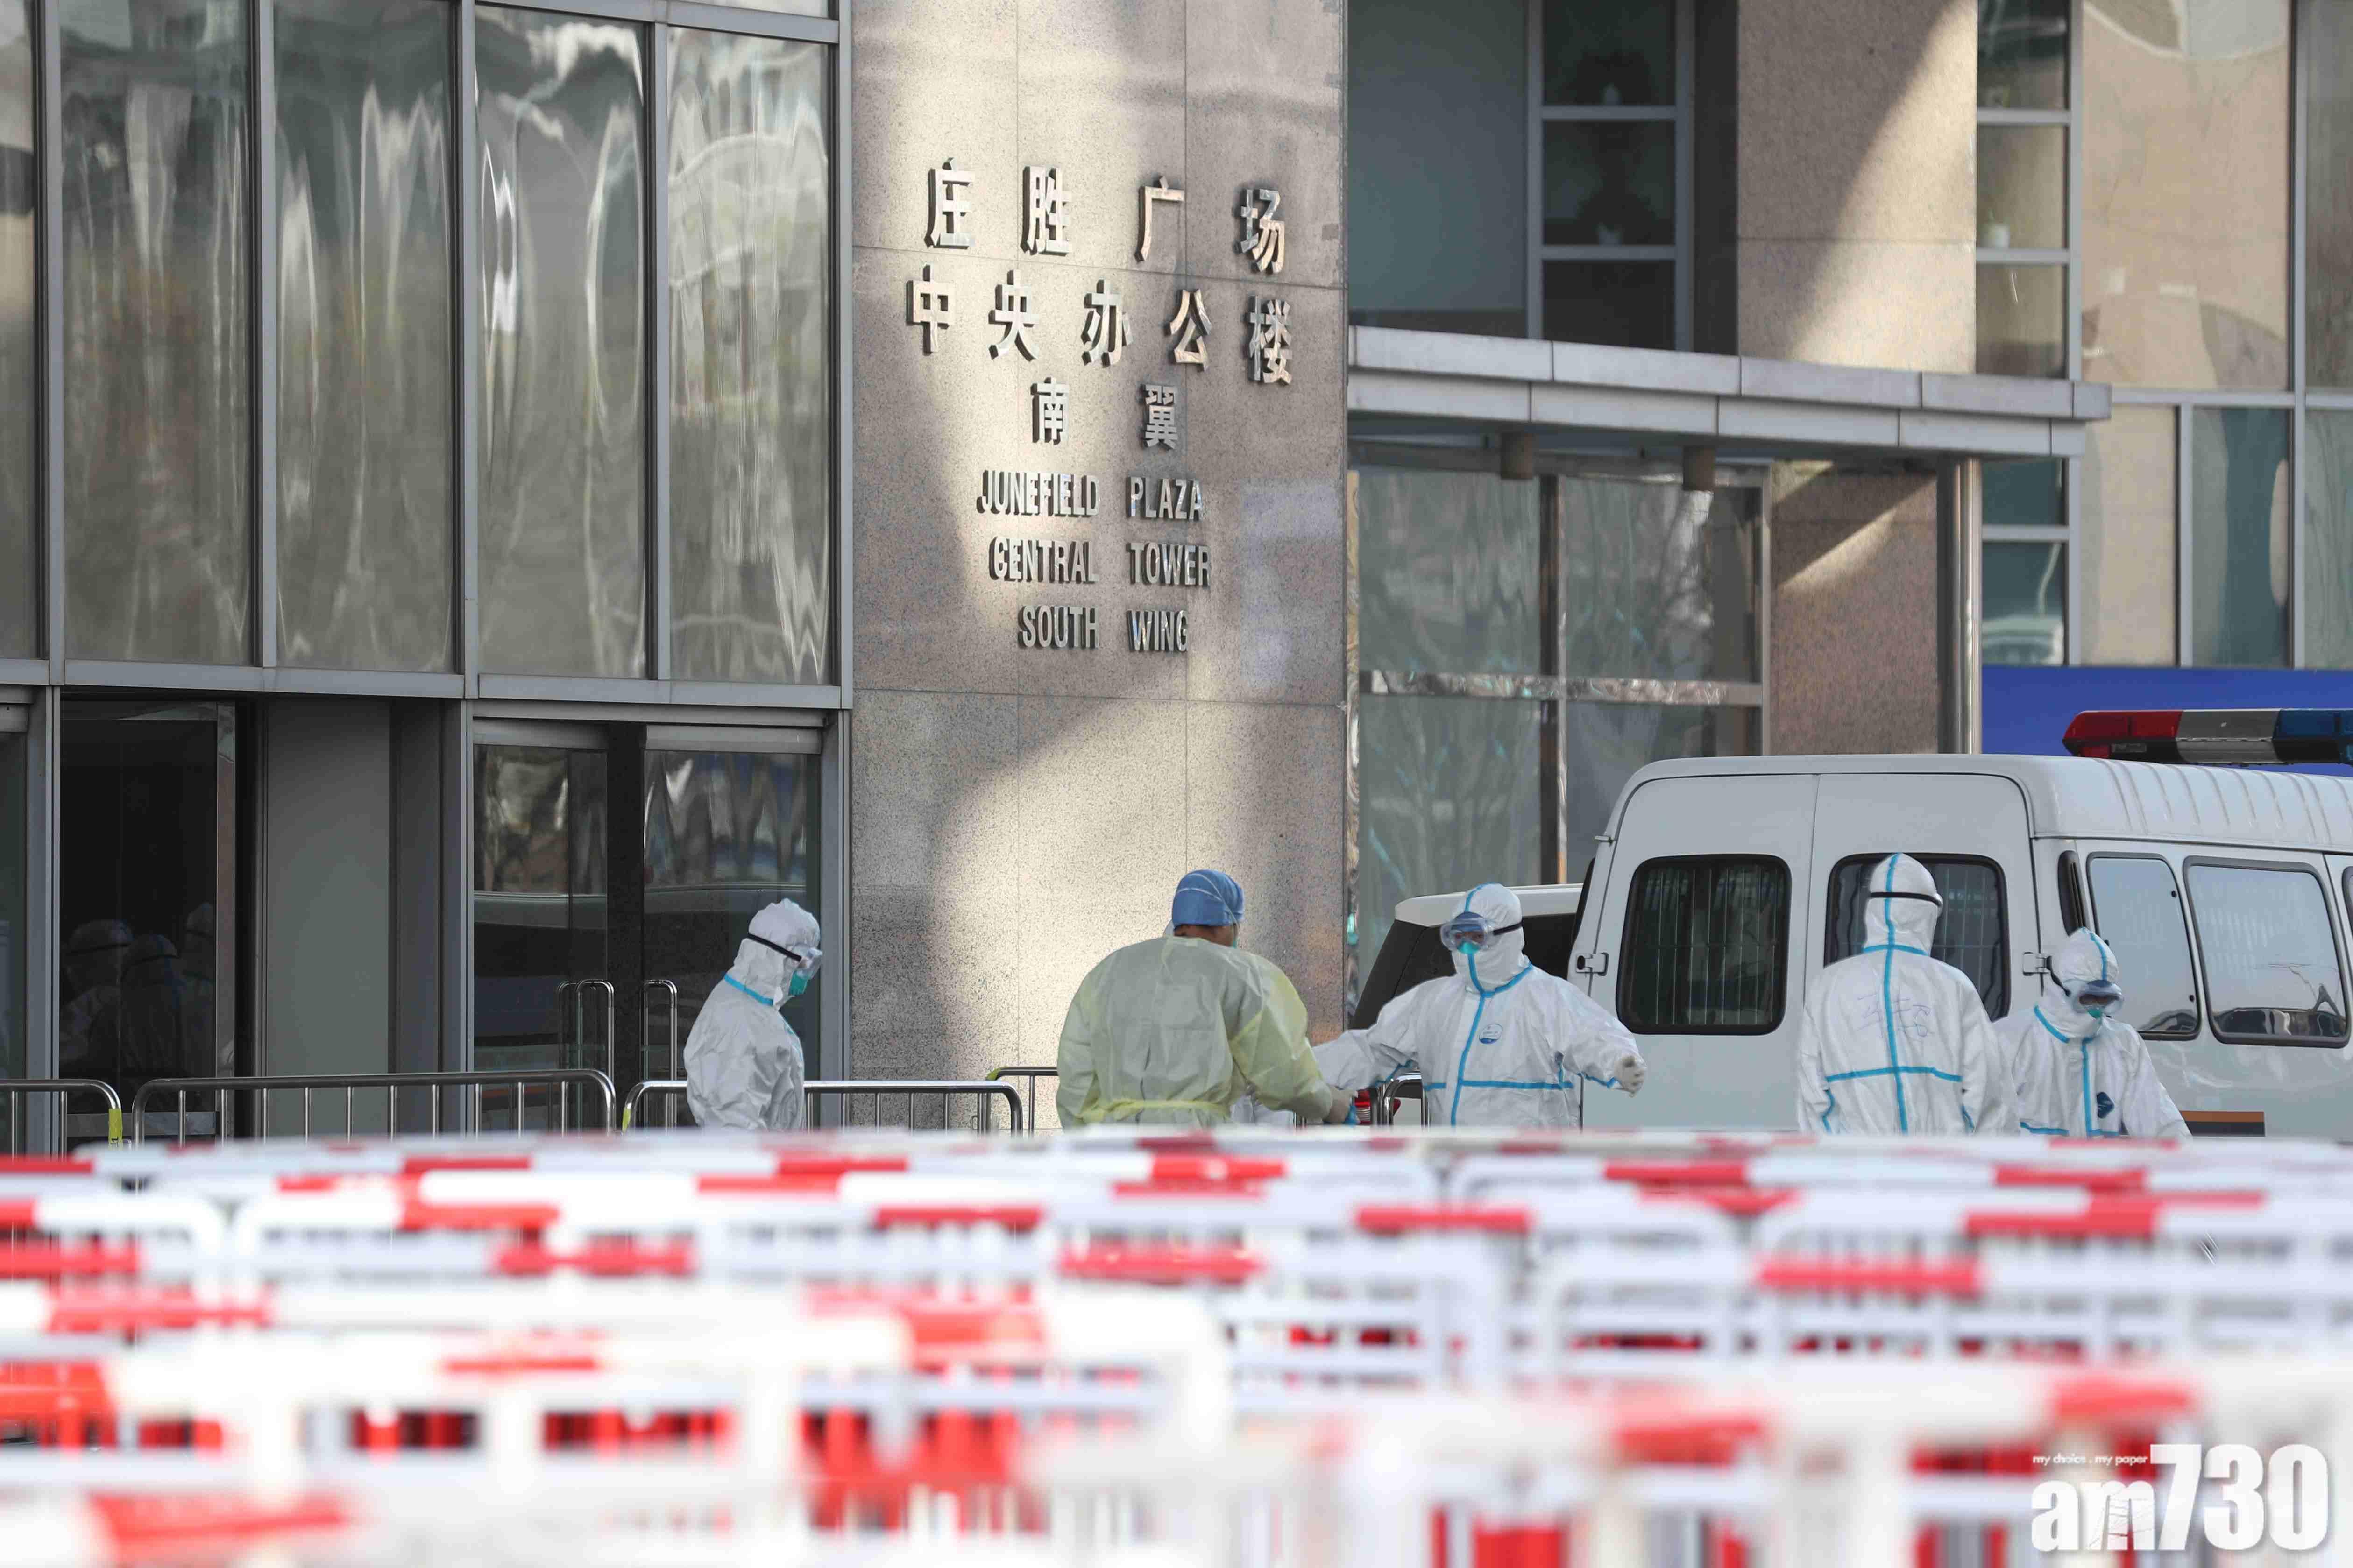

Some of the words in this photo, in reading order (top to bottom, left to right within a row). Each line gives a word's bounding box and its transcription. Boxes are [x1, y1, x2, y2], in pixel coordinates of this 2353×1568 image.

[925, 157, 1285, 273] 庄胜广场
[906, 263, 1292, 384] 中央办公楼
[1031, 377, 1178, 449] 南翼
[977, 470, 1099, 517] JUNEFIELD
[1126, 476, 1204, 520] PLAZA
[989, 537, 1099, 584] CENTRAL
[1126, 542, 1211, 586] TOWER
[1018, 605, 1099, 649] SOUTH
[1126, 610, 1189, 652] WING
